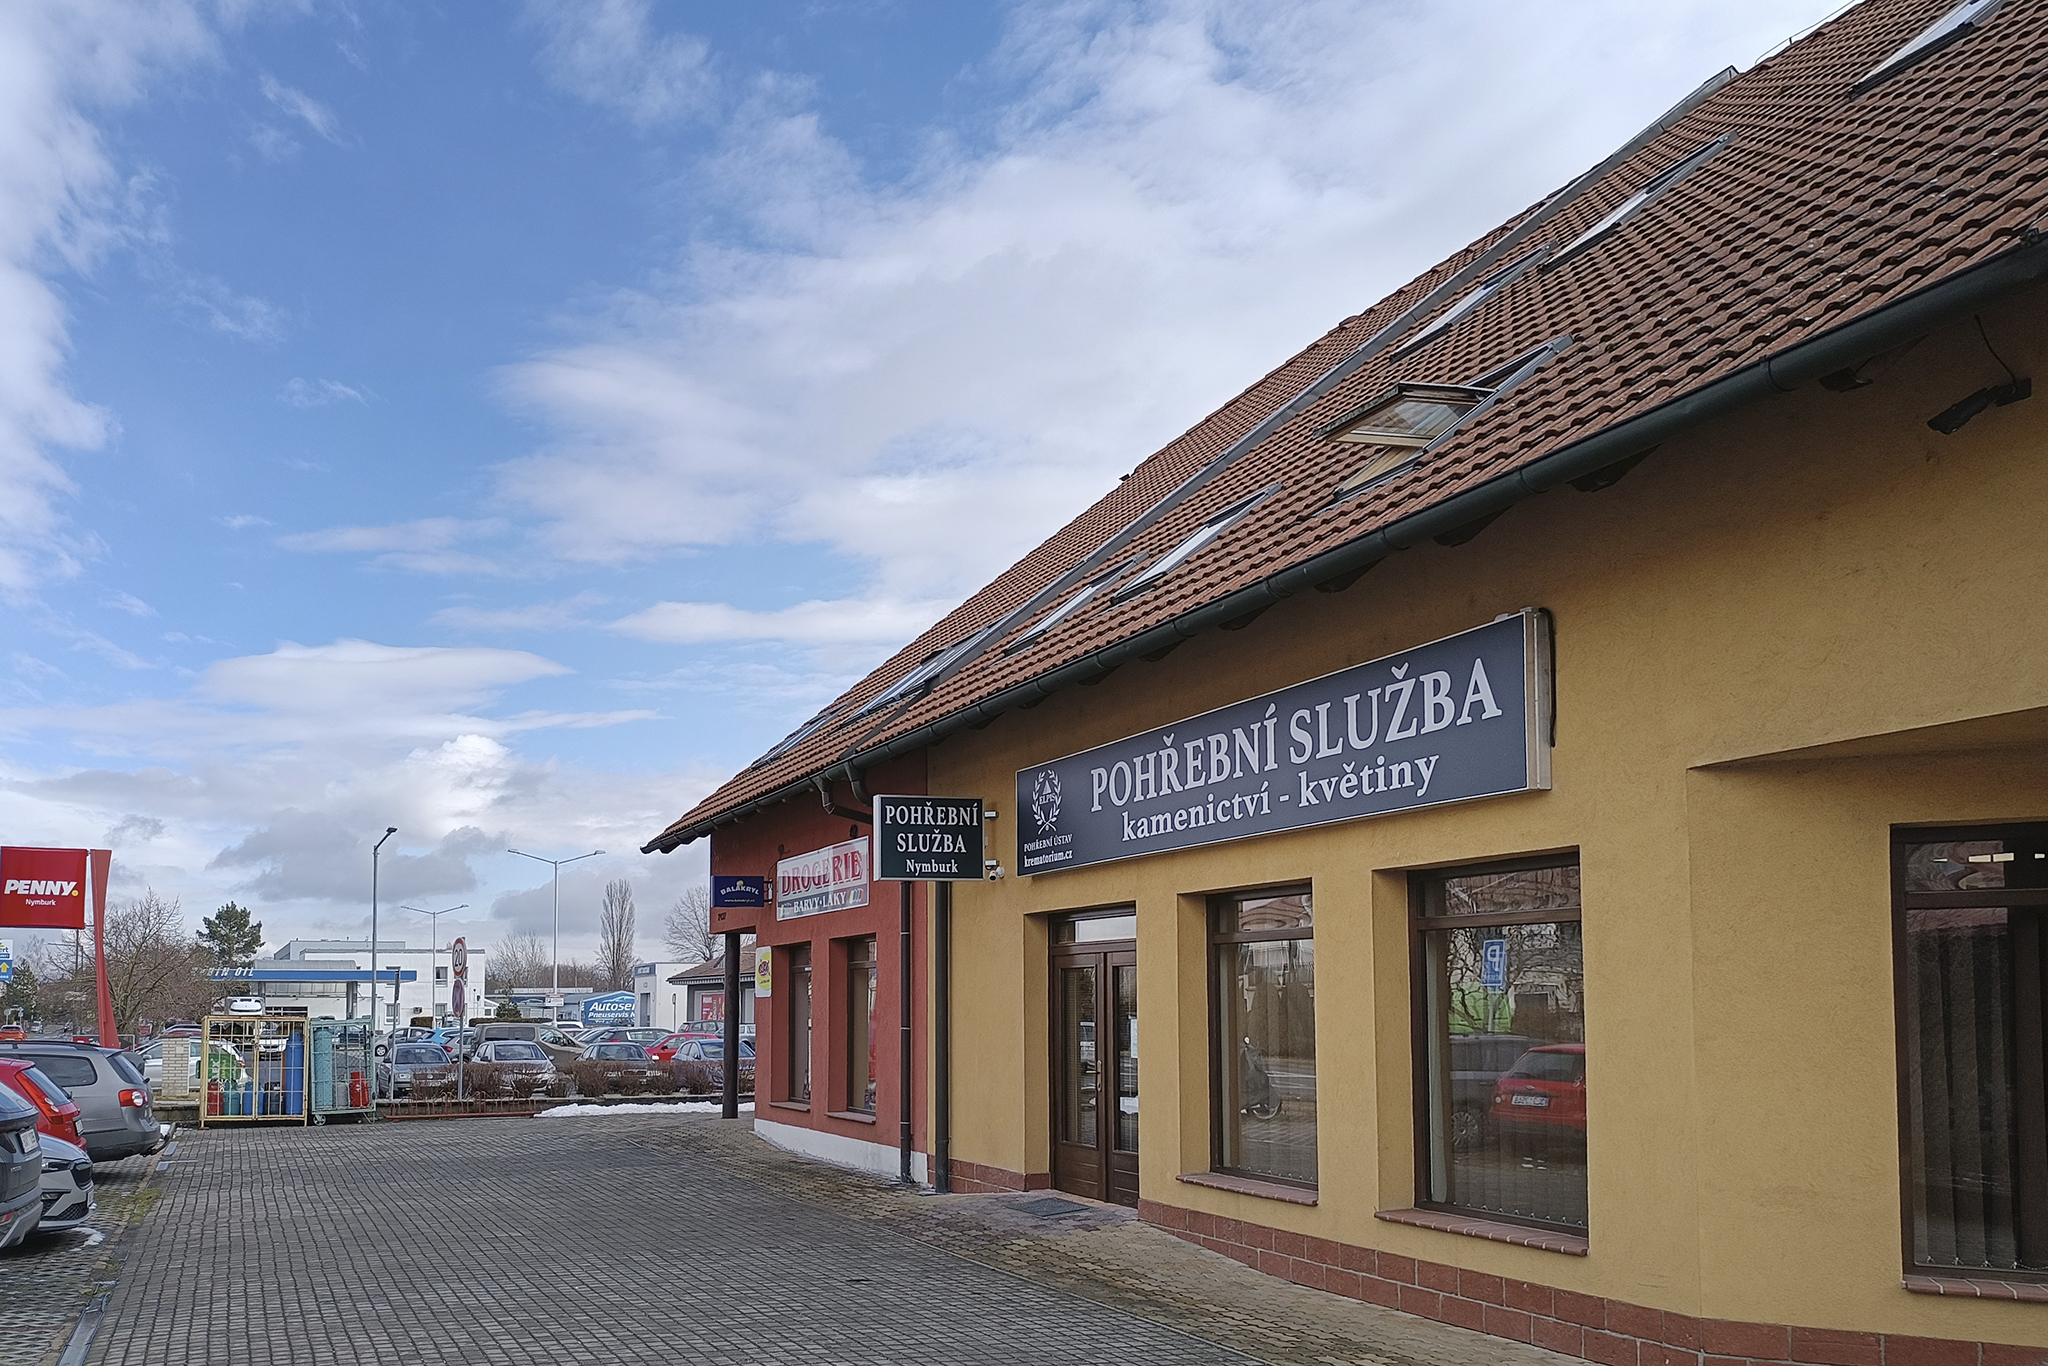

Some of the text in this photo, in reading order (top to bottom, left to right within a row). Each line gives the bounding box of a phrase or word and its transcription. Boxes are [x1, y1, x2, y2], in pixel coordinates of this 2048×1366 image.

[1090, 657, 1502, 812] POHŘEBNÍ SLUŽBA
[1039, 793, 1056, 805] ELPIS
[1121, 781, 1271, 842] kamenictví
[1298, 755, 1440, 808] květiny
[885, 801, 979, 826] POHŘEBNÍ
[897, 829, 967, 853] SLUŽBA
[1024, 834, 1073, 852] POHŘEBNÍ ÚSTAV
[906, 859, 959, 876] Nymburk
[1024, 850, 1073, 868] krematorium.cz
[781, 850, 864, 896] DROGERIE
[720, 885, 760, 896] BALAKRYL
[25, 898, 56, 907] Nymburk
[454, 948, 464, 968] 20
[234, 966, 254, 977] OIL
